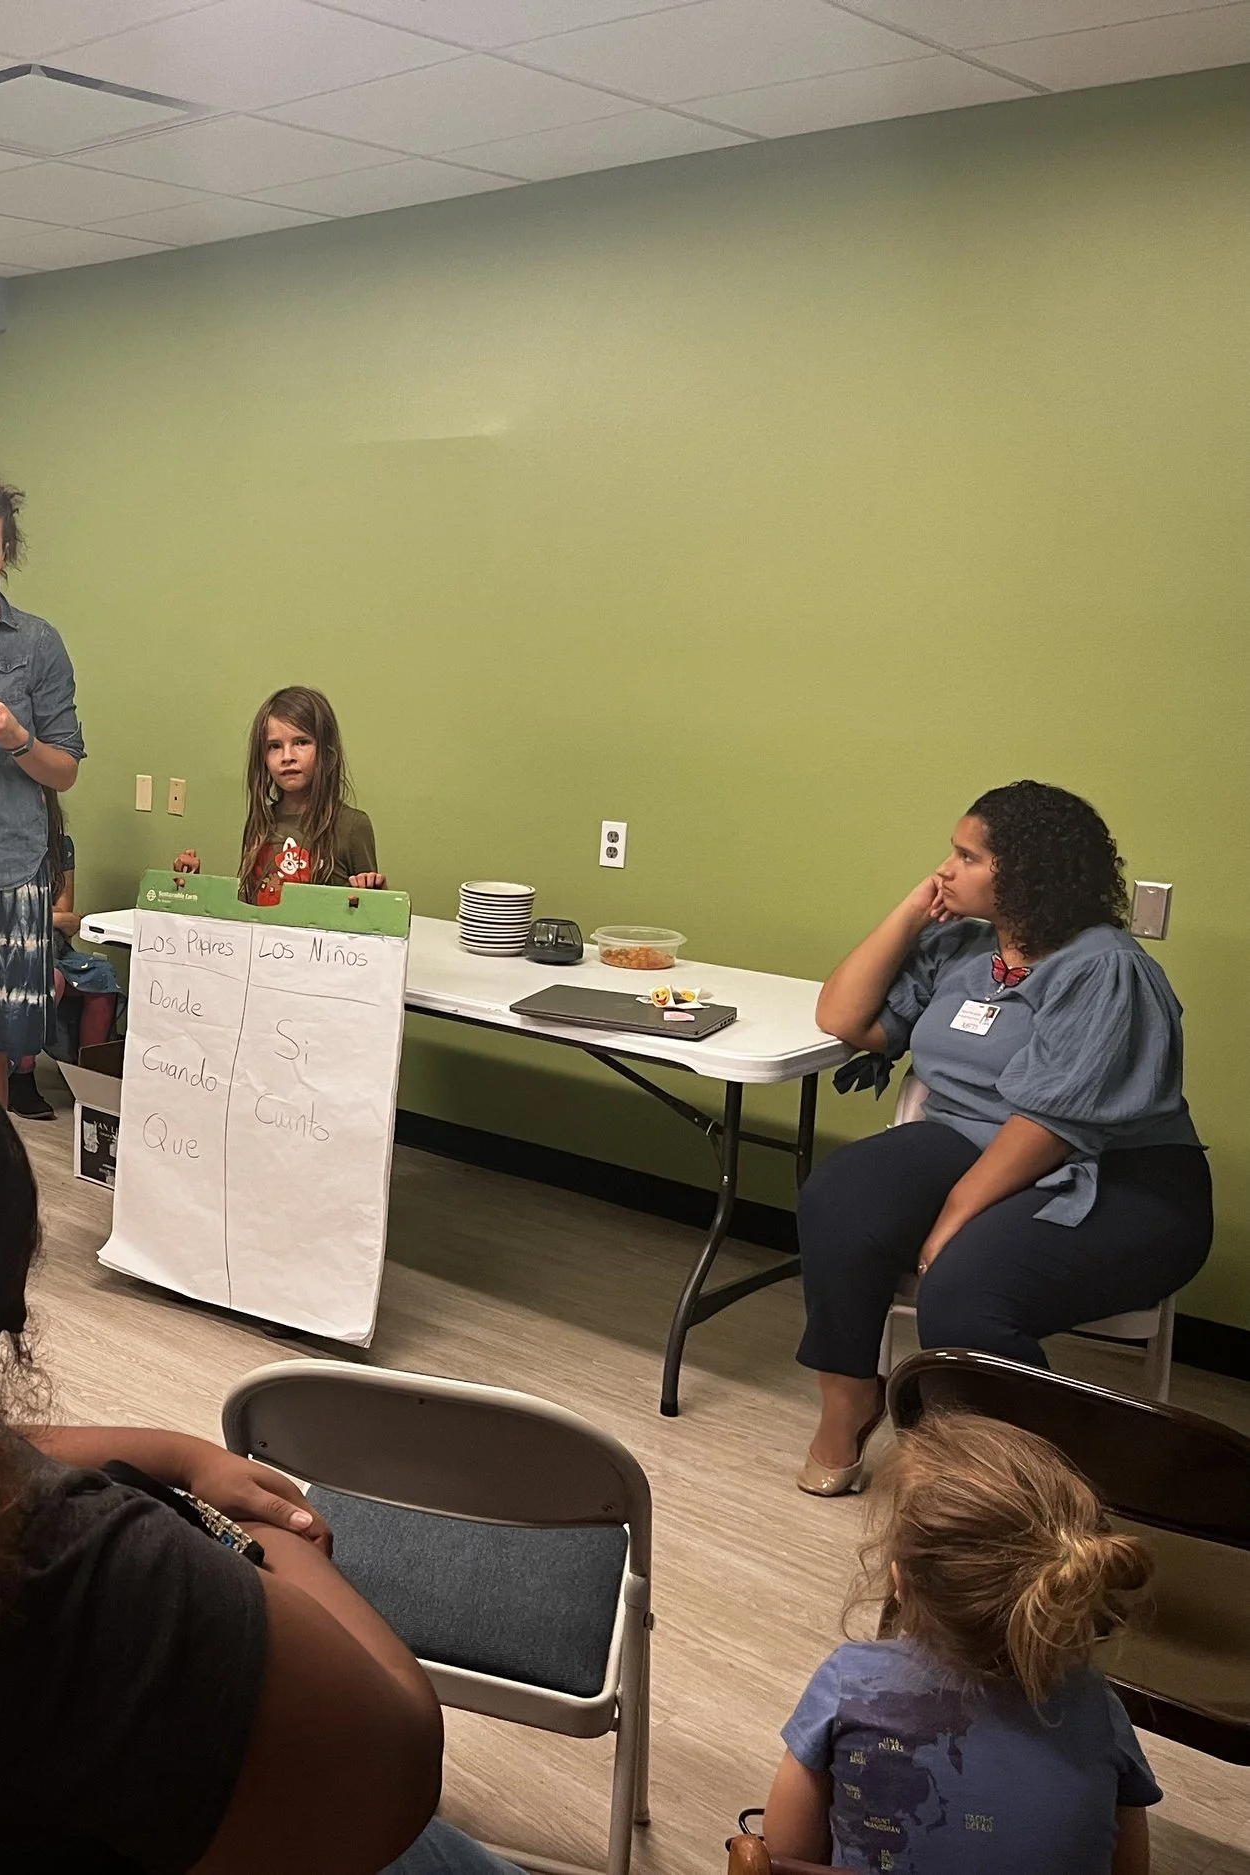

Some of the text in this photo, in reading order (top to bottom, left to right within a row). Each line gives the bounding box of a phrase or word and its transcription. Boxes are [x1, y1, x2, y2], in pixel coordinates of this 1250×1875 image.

[138, 923, 176, 955] Los
[258, 934, 368, 967] Los Niños
[149, 979, 203, 1017] Donde
[273, 1018, 309, 1065] Si
[142, 1044, 217, 1092] Cuando
[142, 1112, 200, 1159] Que
